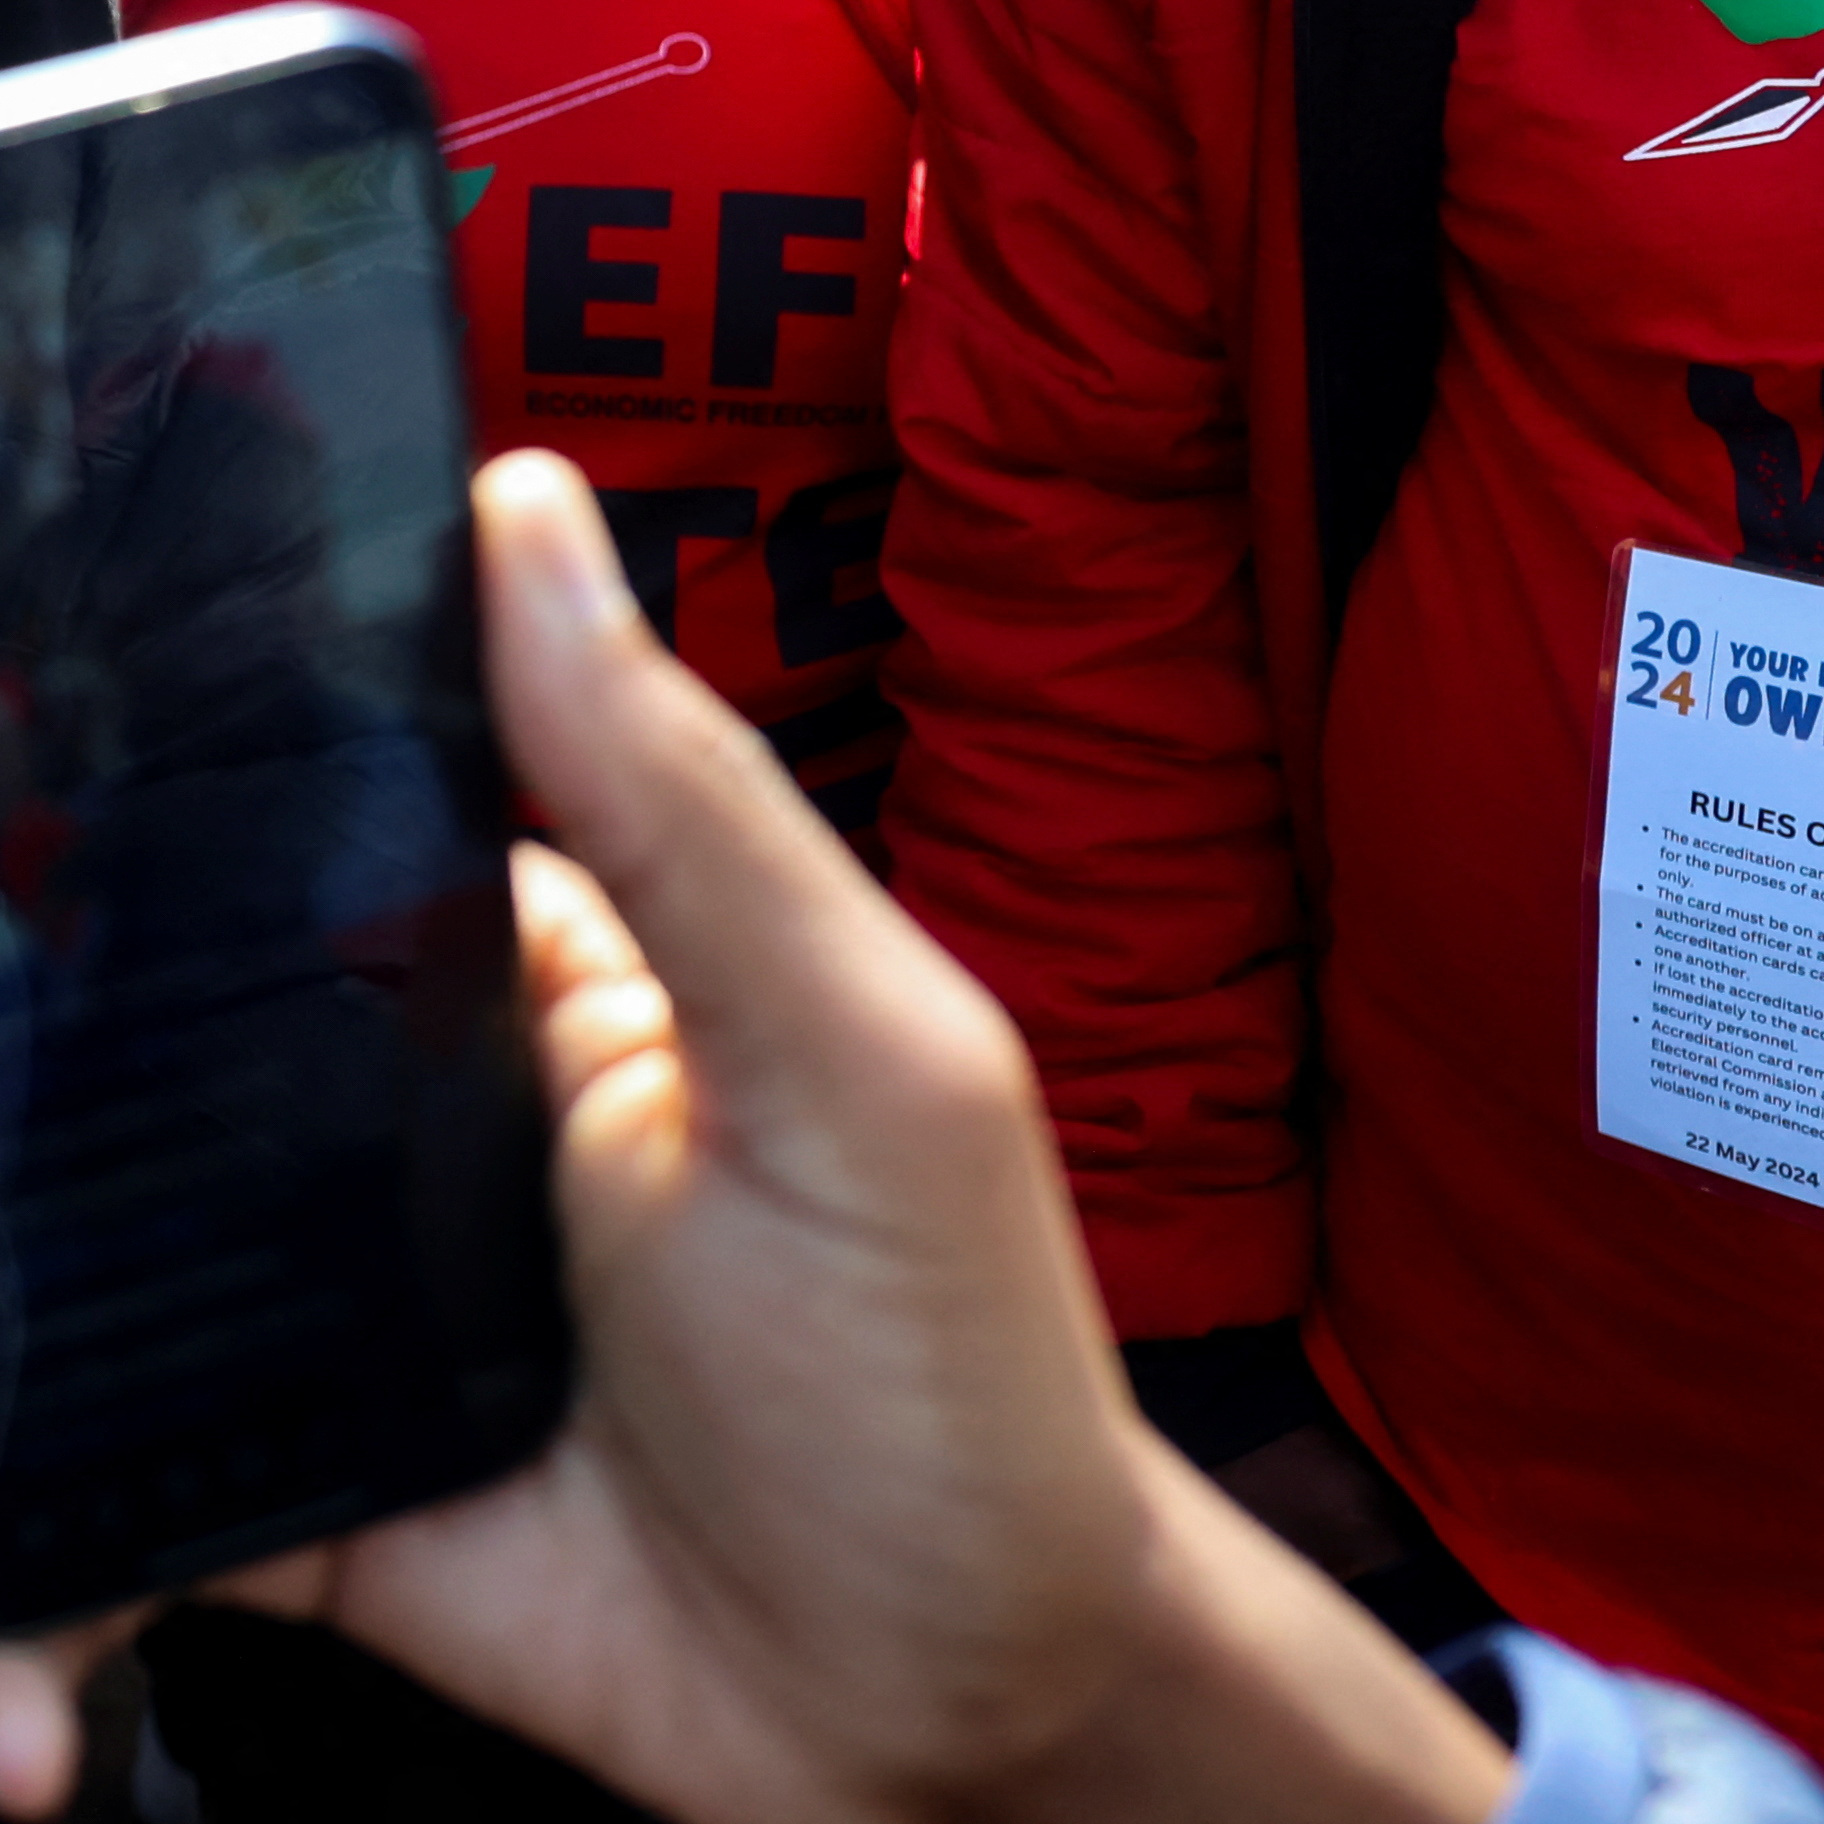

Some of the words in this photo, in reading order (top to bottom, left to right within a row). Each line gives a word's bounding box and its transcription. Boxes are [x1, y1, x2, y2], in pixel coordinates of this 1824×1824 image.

[524, 186, 866, 390] EF
[525, 389, 696, 423] ECONOMIC
[707, 399, 867, 426] FREEDOM
[1631, 610, 1702, 665] 20
[1730, 641, 1809, 683] YOUR
[1626, 660, 1696, 717] 24
[1724, 675, 1824, 742] OW
[1690, 790, 1796, 839] RULES
[1660, 846, 1681, 863] for
[1686, 854, 1710, 871] the
[1714, 863, 1786, 891] purposes
[1790, 883, 1807, 896] of
[1662, 827, 1689, 845] The
[1693, 838, 1795, 873] accreditation
[1658, 869, 1693, 889] only.
[1655, 907, 1736, 938] authorized
[1740, 930, 1792, 952] officer
[1797, 946, 1812, 959] at
[1657, 886, 1683, 905] The
[1688, 897, 1721, 915] card
[1726, 907, 1764, 927] must
[1769, 915, 1788, 932] be
[1793, 925, 1812, 938] on
[1655, 925, 1757, 963] Accreditation
[1762, 956, 1805, 976] cards
[1655, 945, 1682, 962] one
[1685, 954, 1749, 981] another.
[1654, 962, 1665, 975] If
[1668, 965, 1695, 985] lost
[1700, 975, 1725, 993] the
[1652, 1020, 1753, 1060] Accreditation
[1758, 1053, 1793, 1071] card
[1653, 1002, 1712, 1030] security
[1717, 1021, 1798, 1052] personnel.
[1751, 1009, 1767, 1024] to
[1771, 1015, 1797, 1033] the
[1652, 1037, 1717, 1069] Electoral
[1721, 1059, 1816, 1097] Commission
[1652, 1058, 1718, 1088] retrieved
[1723, 1078, 1759, 1100] from
[1763, 1093, 1791, 1112] any
[1652, 1077, 1715, 1105] violation
[1719, 1096, 1730, 1110] is
[1686, 1132, 1709, 1153] 22
[1716, 1141, 1760, 1172] May
[1765, 1157, 1820, 1189] 2024
